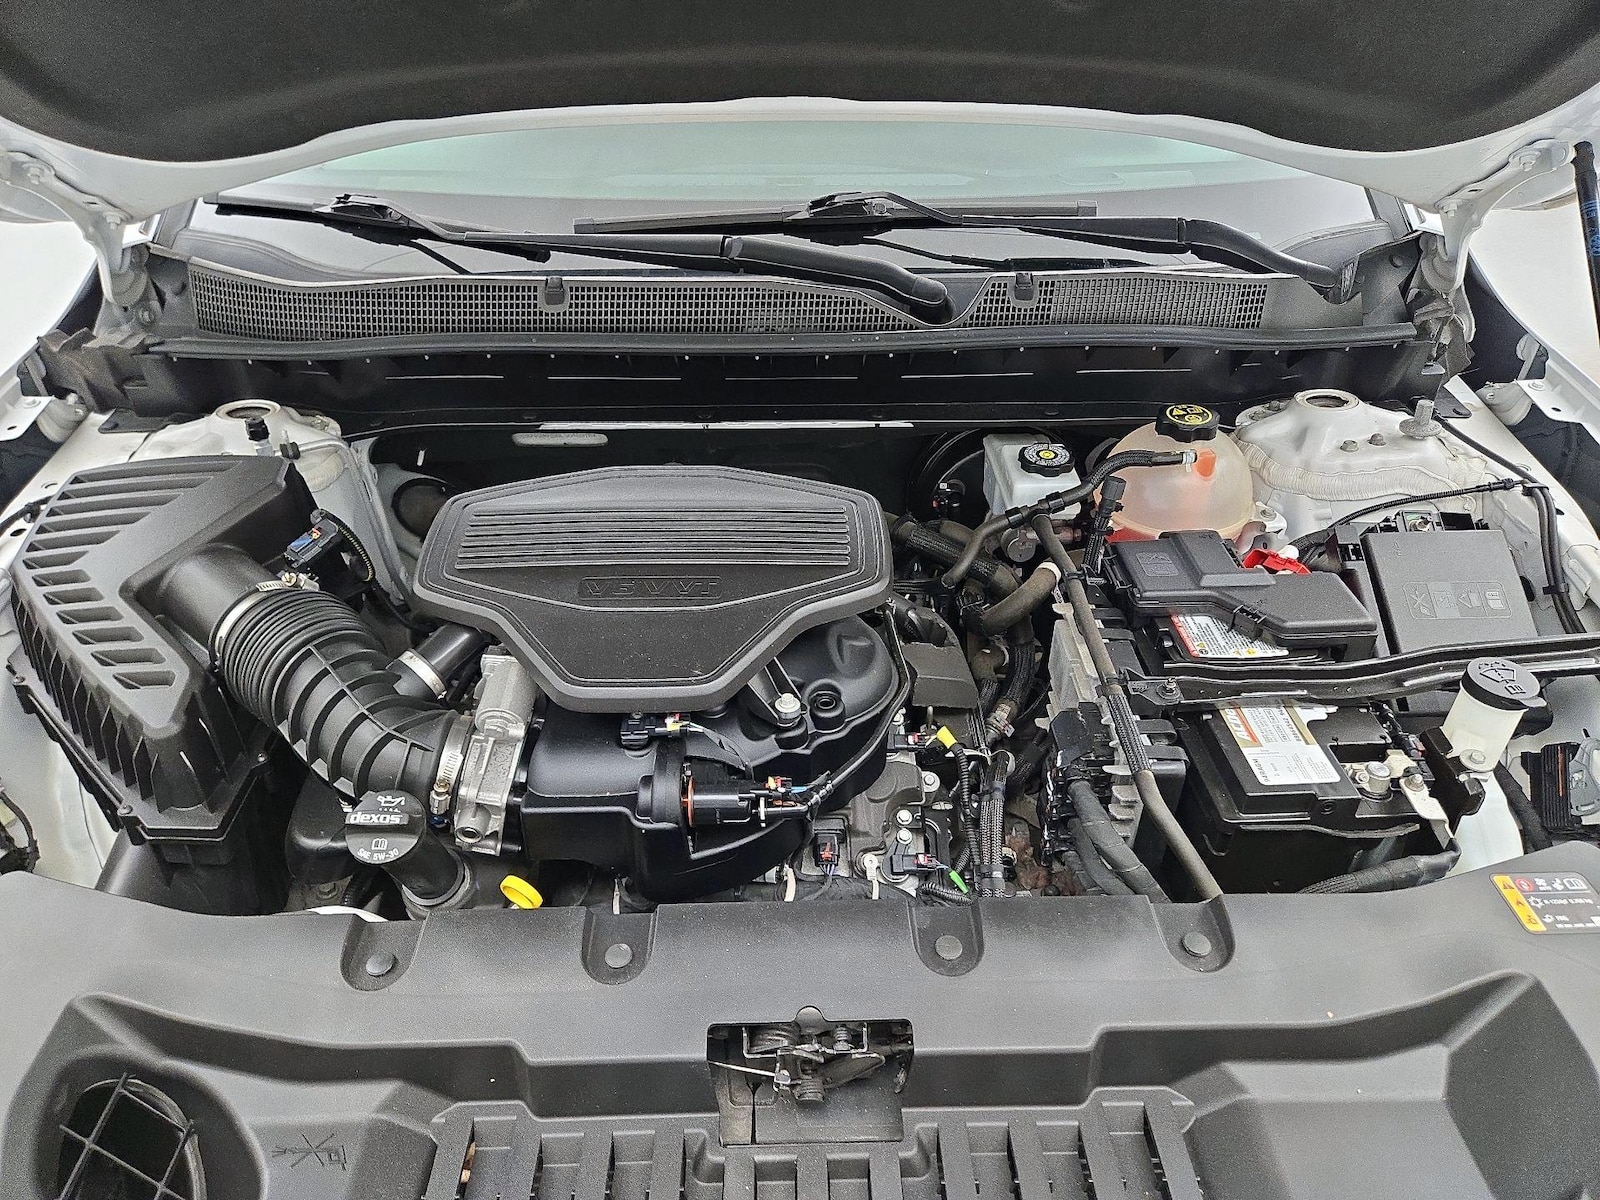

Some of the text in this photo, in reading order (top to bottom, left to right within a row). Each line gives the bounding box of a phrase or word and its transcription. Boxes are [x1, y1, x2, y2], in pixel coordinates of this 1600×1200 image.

[643, 580, 719, 595] VVT
[350, 812, 403, 824] dexos
[357, 848, 399, 860] SAE 5W-30
